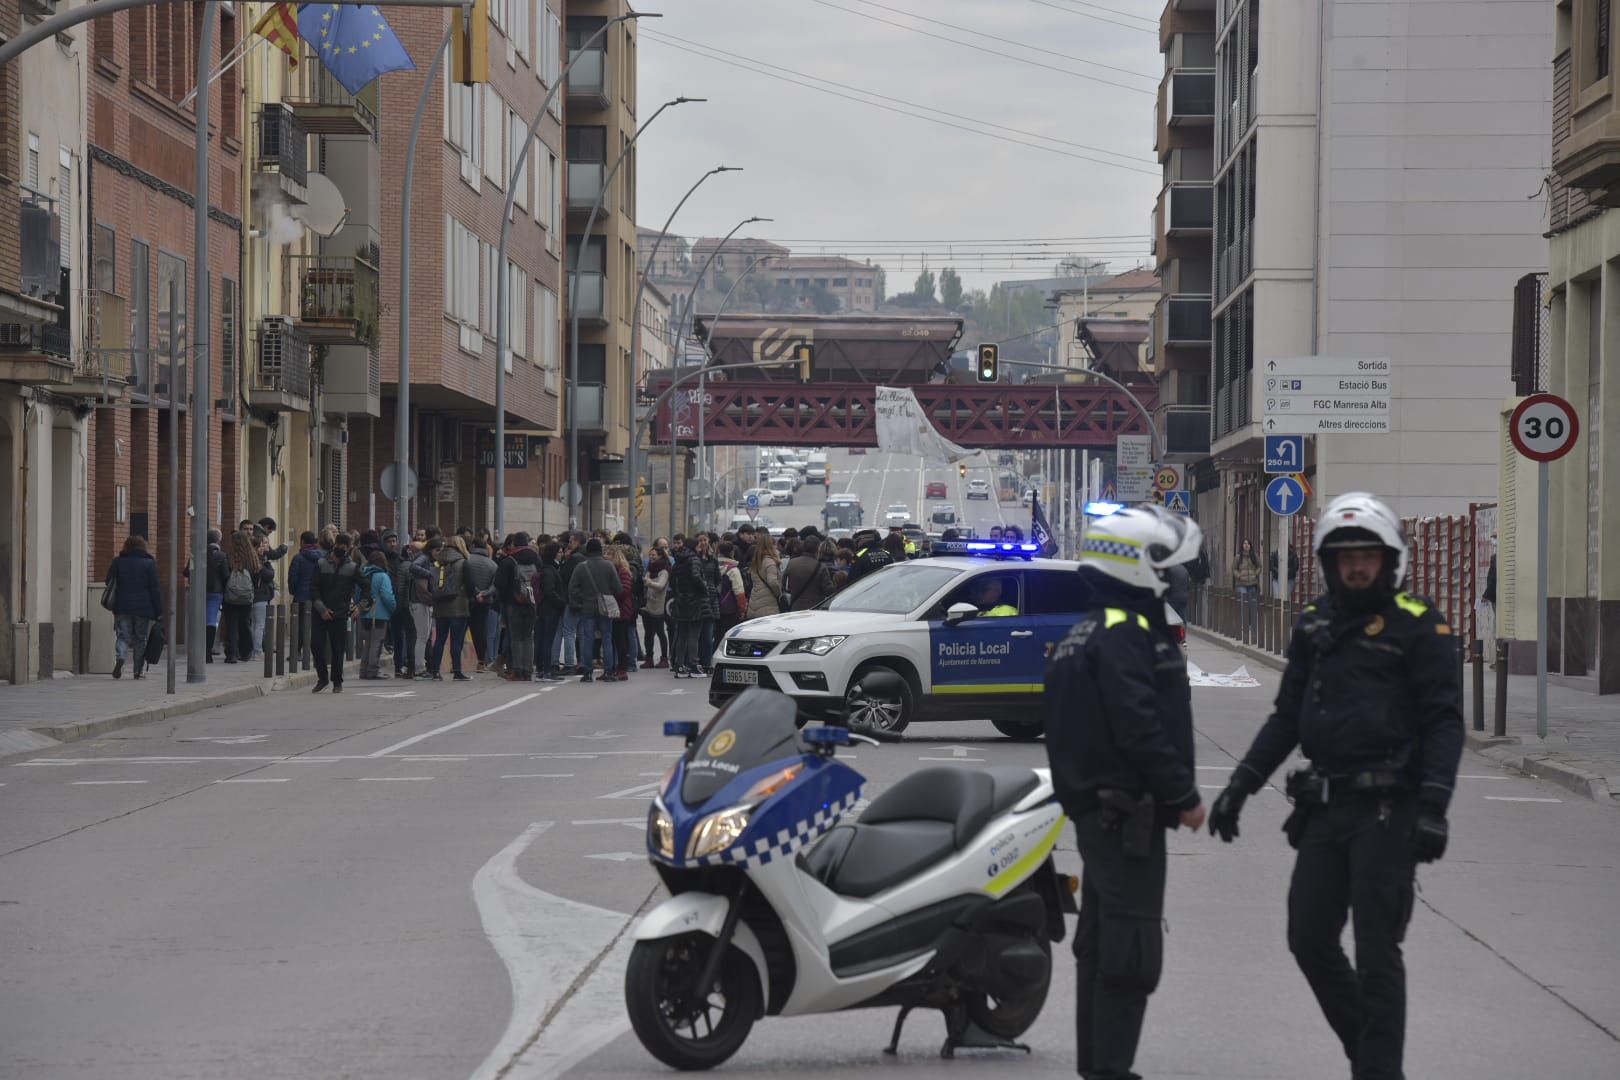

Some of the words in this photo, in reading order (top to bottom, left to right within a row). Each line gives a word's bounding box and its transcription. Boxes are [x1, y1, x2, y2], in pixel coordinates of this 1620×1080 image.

[1357, 361, 1387, 370] Sortida
[1339, 380, 1370, 390] Estació
[1371, 381, 1387, 390] Bus
[1313, 400, 1331, 409] FGC
[1333, 400, 1369, 409] Manresa
[1370, 400, 1387, 409] Alta
[1318, 420, 1342, 429] Altres
[1344, 420, 1387, 429] direccions
[1524, 417, 1564, 439] 30
[1159, 474, 1174, 484] 20
[938, 642, 977, 656] Policia
[979, 641, 1010, 655] Local
